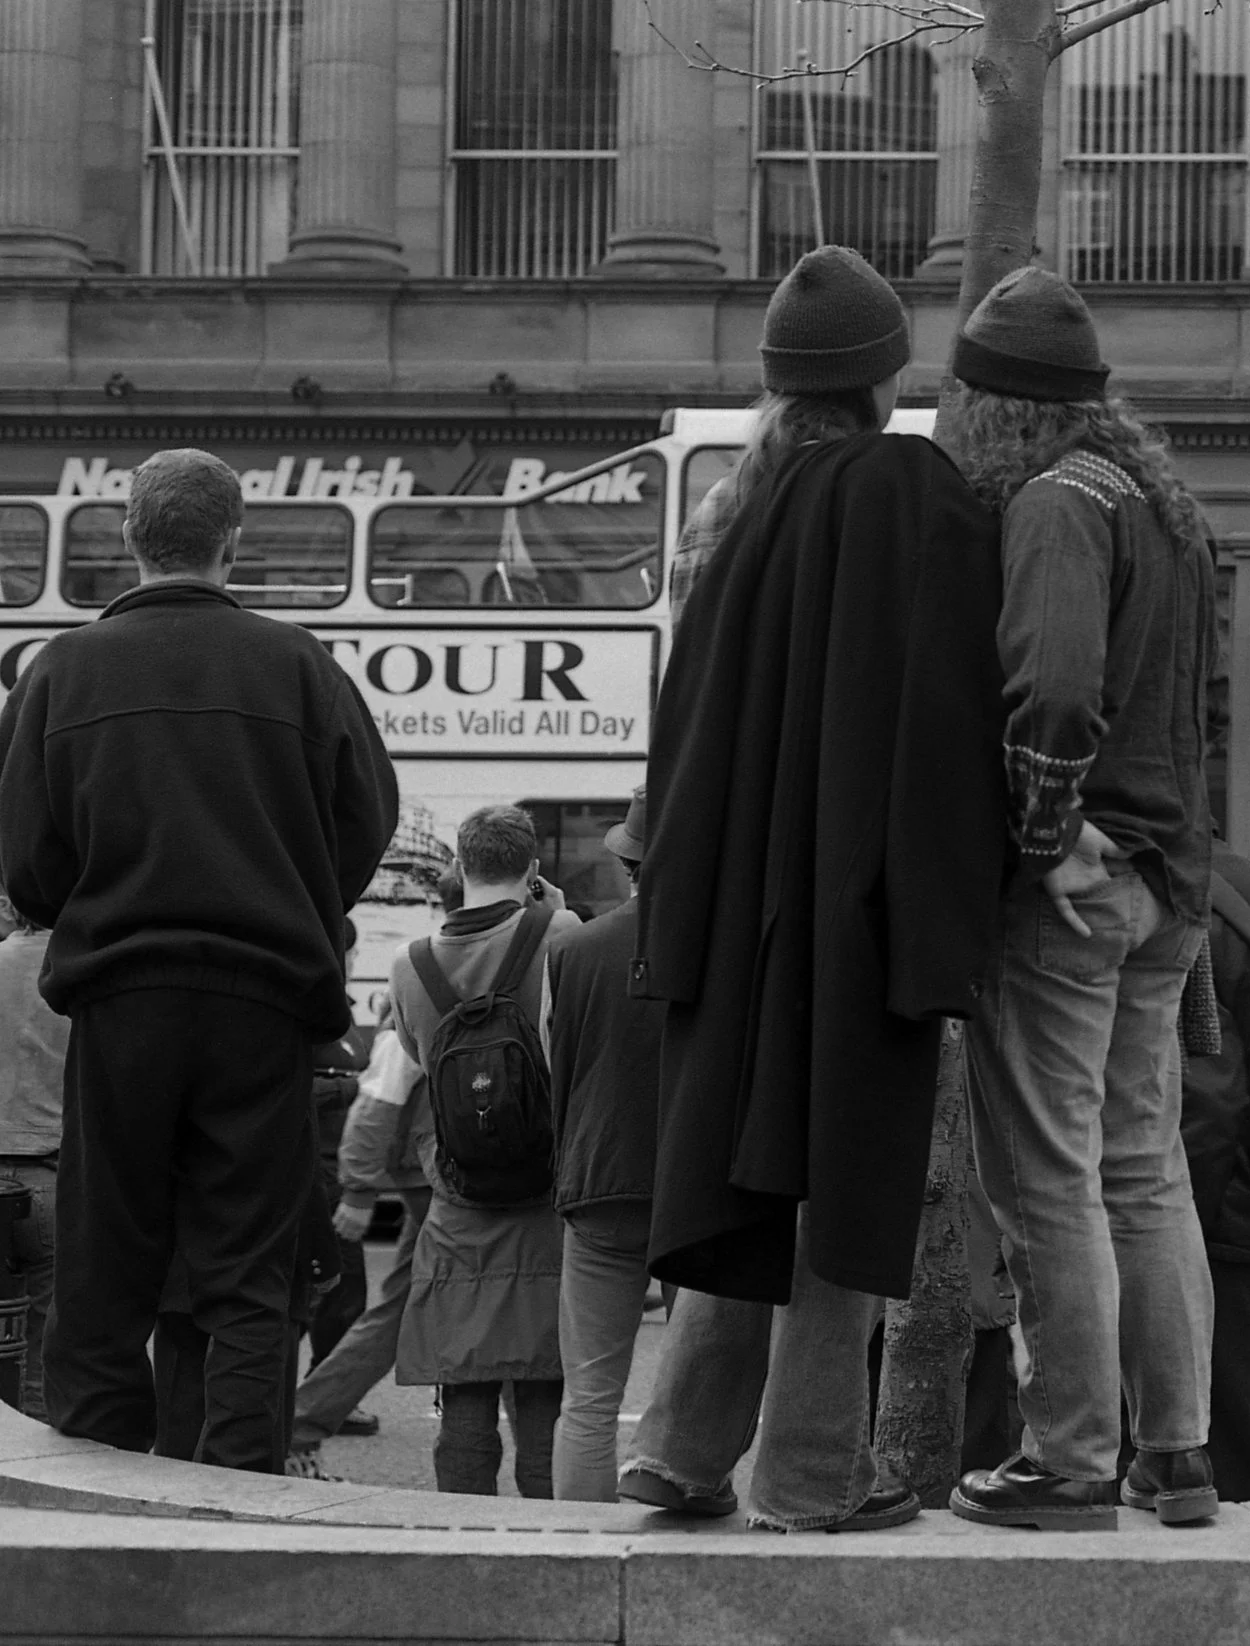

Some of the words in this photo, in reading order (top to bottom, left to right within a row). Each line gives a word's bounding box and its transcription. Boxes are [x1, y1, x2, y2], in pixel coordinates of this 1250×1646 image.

[57, 456, 296, 496] Naal
[297, 455, 415, 497] Irish
[373, 709, 447, 735] kets
[457, 710, 525, 735] Valid
[535, 710, 569, 735] All
[580, 710, 635, 742] Day
